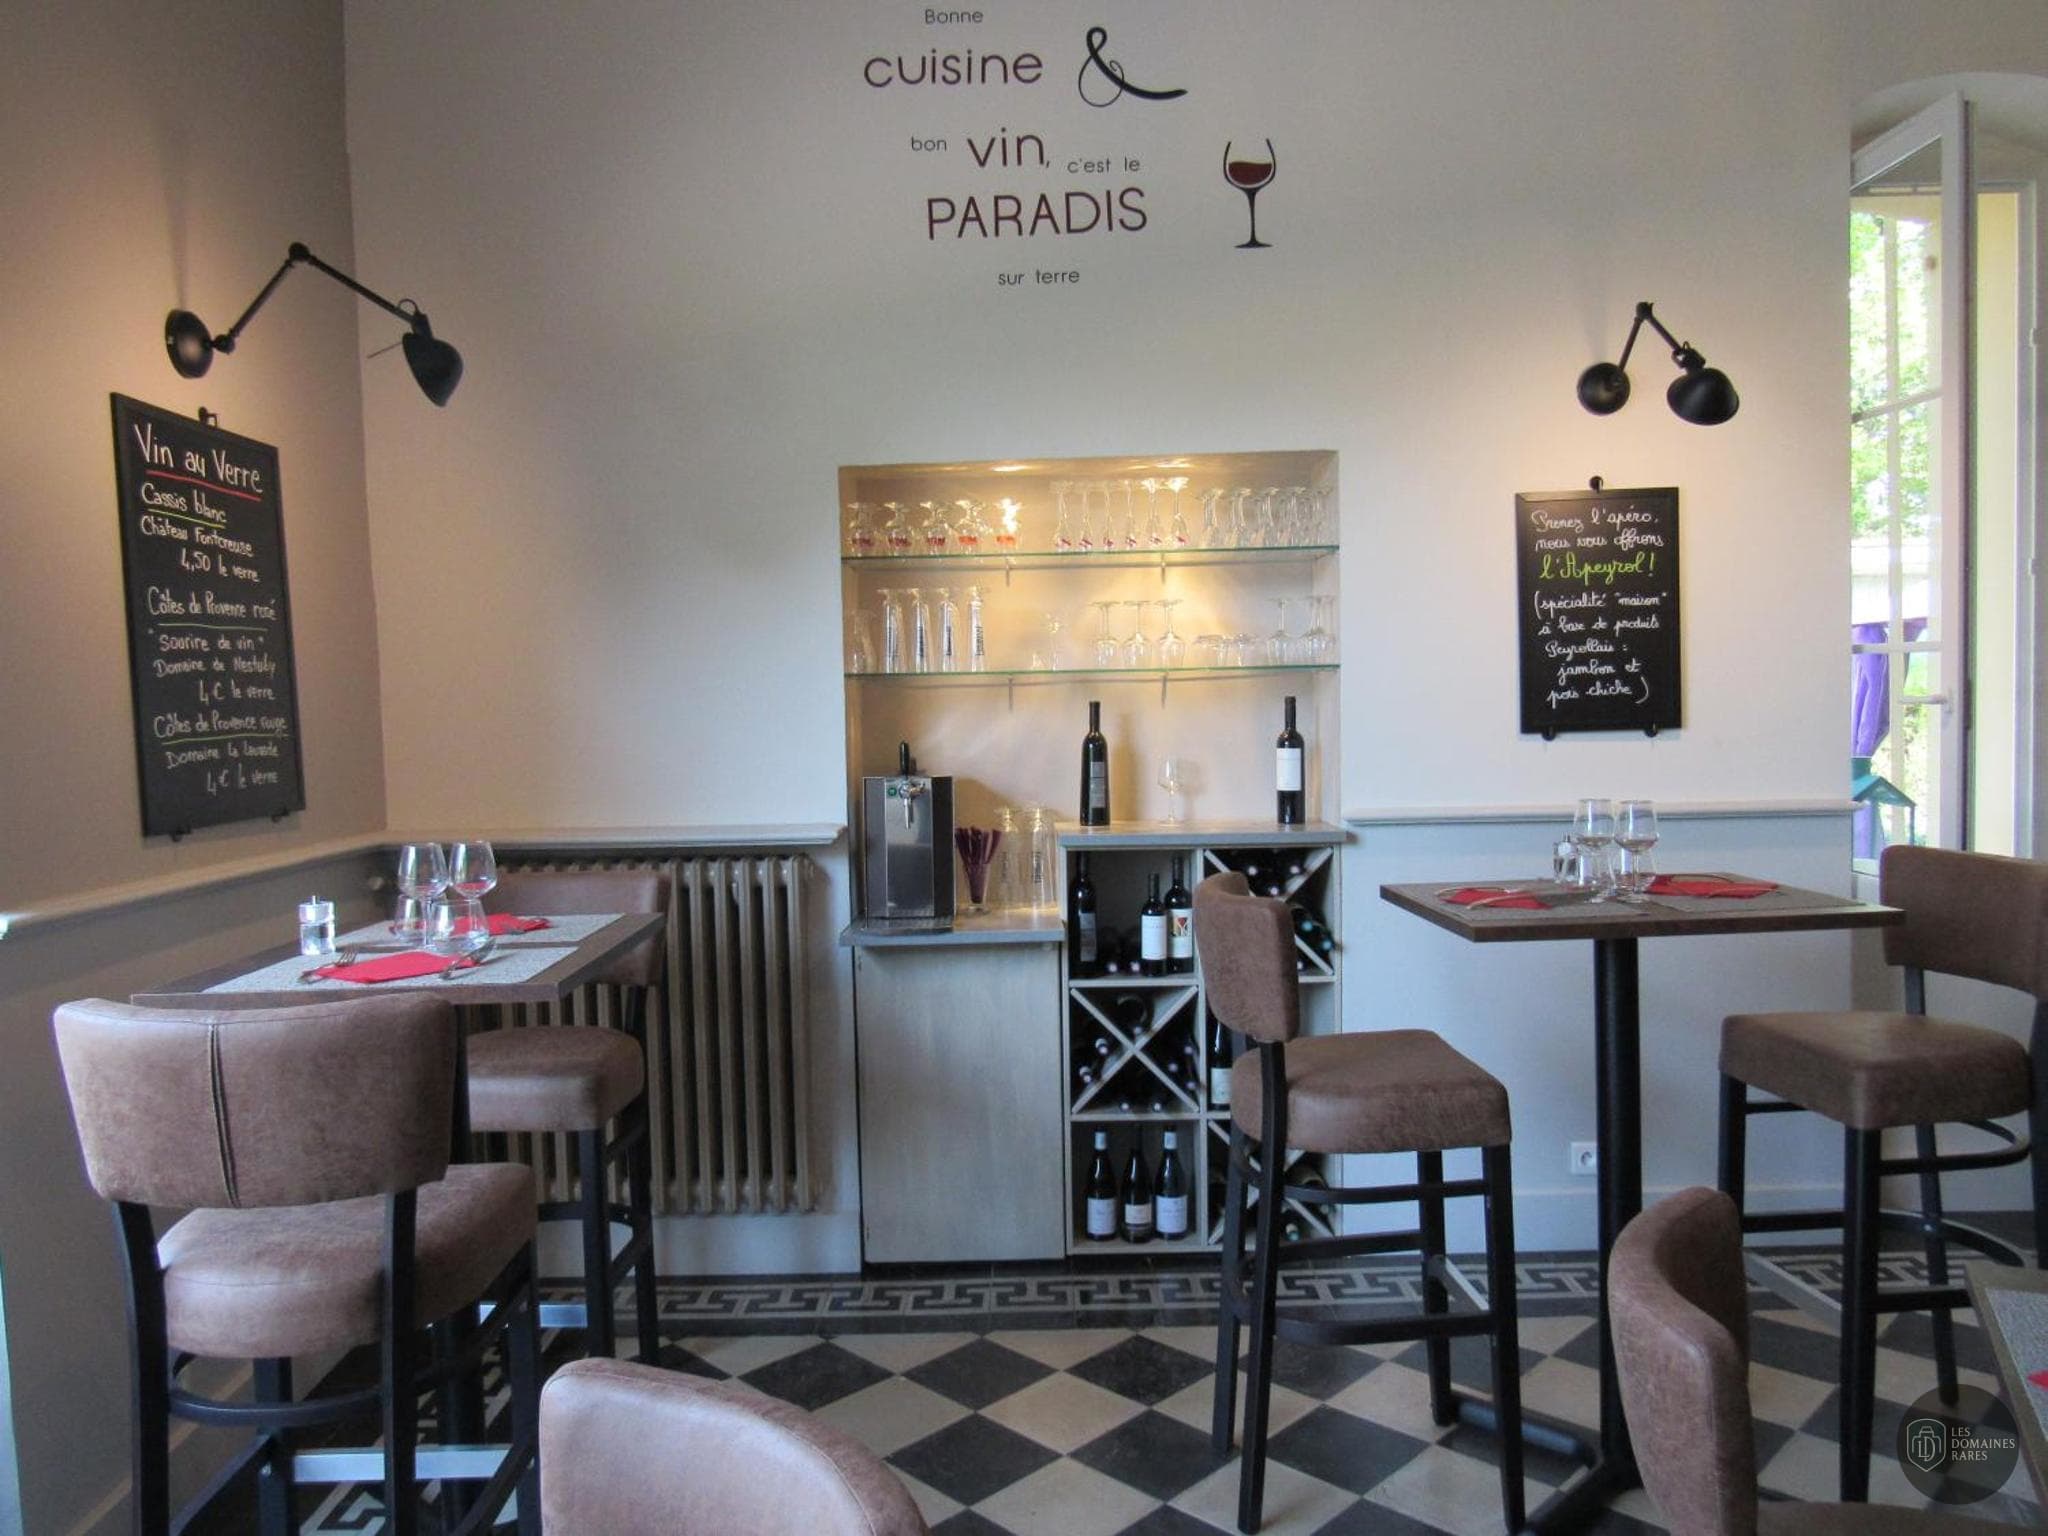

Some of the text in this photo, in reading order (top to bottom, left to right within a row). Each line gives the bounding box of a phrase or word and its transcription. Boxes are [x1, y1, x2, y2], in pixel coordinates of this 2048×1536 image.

[924, 9, 984, 25] Bonne
[863, 26, 1188, 107] cuisine &
[911, 127, 1141, 174] bon vin, c'est le
[927, 187, 1149, 241] PARADIS
[998, 268, 1080, 287] sur terre
[133, 423, 263, 493] Vin au Verre
[141, 482, 227, 522] Cassis blanc
[1531, 509, 1585, 534] Prenez
[1557, 657, 1643, 687] jambon et
[1546, 689, 1580, 710] pois
